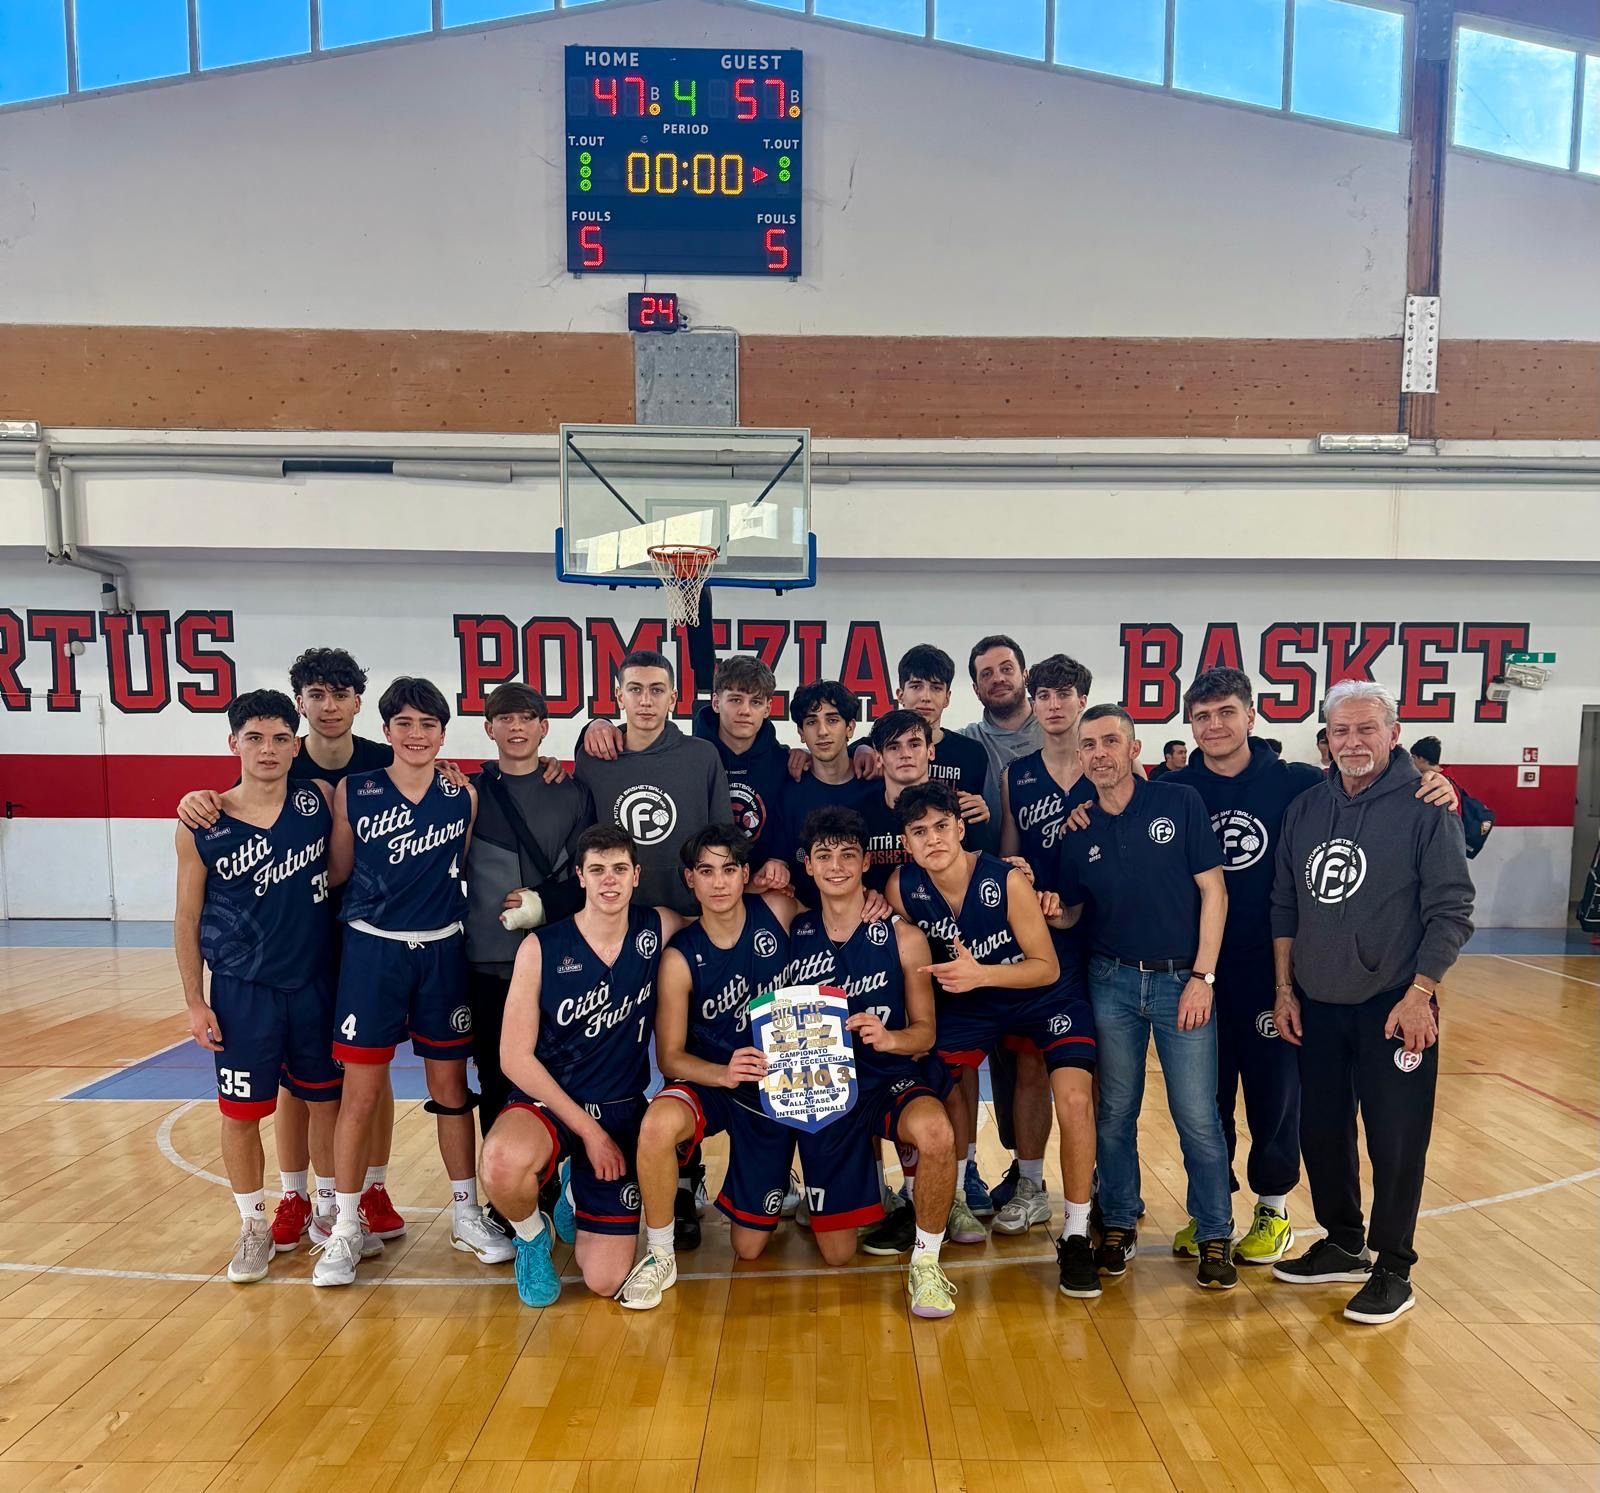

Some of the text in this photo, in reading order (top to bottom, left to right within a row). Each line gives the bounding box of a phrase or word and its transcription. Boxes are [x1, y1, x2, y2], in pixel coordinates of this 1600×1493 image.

[585, 51, 639, 67] HOME
[721, 54, 782, 70] GUEST
[594, 77, 645, 115] 47
[650, 87, 660, 101] B
[674, 79, 696, 116] 4
[735, 78, 785, 120] 57
[790, 90, 800, 103] B
[568, 135, 605, 147] T.OUT
[663, 123, 709, 135] PERIOD
[763, 138, 800, 150] T.OUT
[628, 152, 743, 195] 00:00
[571, 210, 611, 222] FOULS
[757, 213, 797, 225] FOULS
[580, 225, 603, 267] 5
[766, 228, 788, 270] 5
[640, 296, 674, 325] 24
[1118, 622, 1531, 724] BASKET
[357, 803, 415, 844] Città
[1018, 793, 1064, 831] Città
[387, 818, 466, 865] Futura
[215, 833, 273, 881] Città
[252, 836, 325, 897] Futura
[448, 852, 460, 879] 4
[789, 949, 837, 986] Città
[556, 980, 609, 1027] Città
[702, 973, 750, 1020] Città
[734, 963, 790, 1033] Ftura
[796, 1000, 827, 1015] FIP
[340, 1013, 357, 1041] 4
[768, 1062, 787, 1070] NDER
[800, 1055, 848, 1066] ECCELLENZA
[780, 1048, 828, 1059] CAMPIONATO
[220, 1067, 251, 1098] 35
[764, 1066, 851, 1093] LAZIO 3
[808, 1086, 847, 1097] AMMESSA
[776, 1104, 845, 1117] INTERREGIONALE
[789, 1097, 831, 1107] ALLA FASE
[806, 1186, 825, 1212] 17
